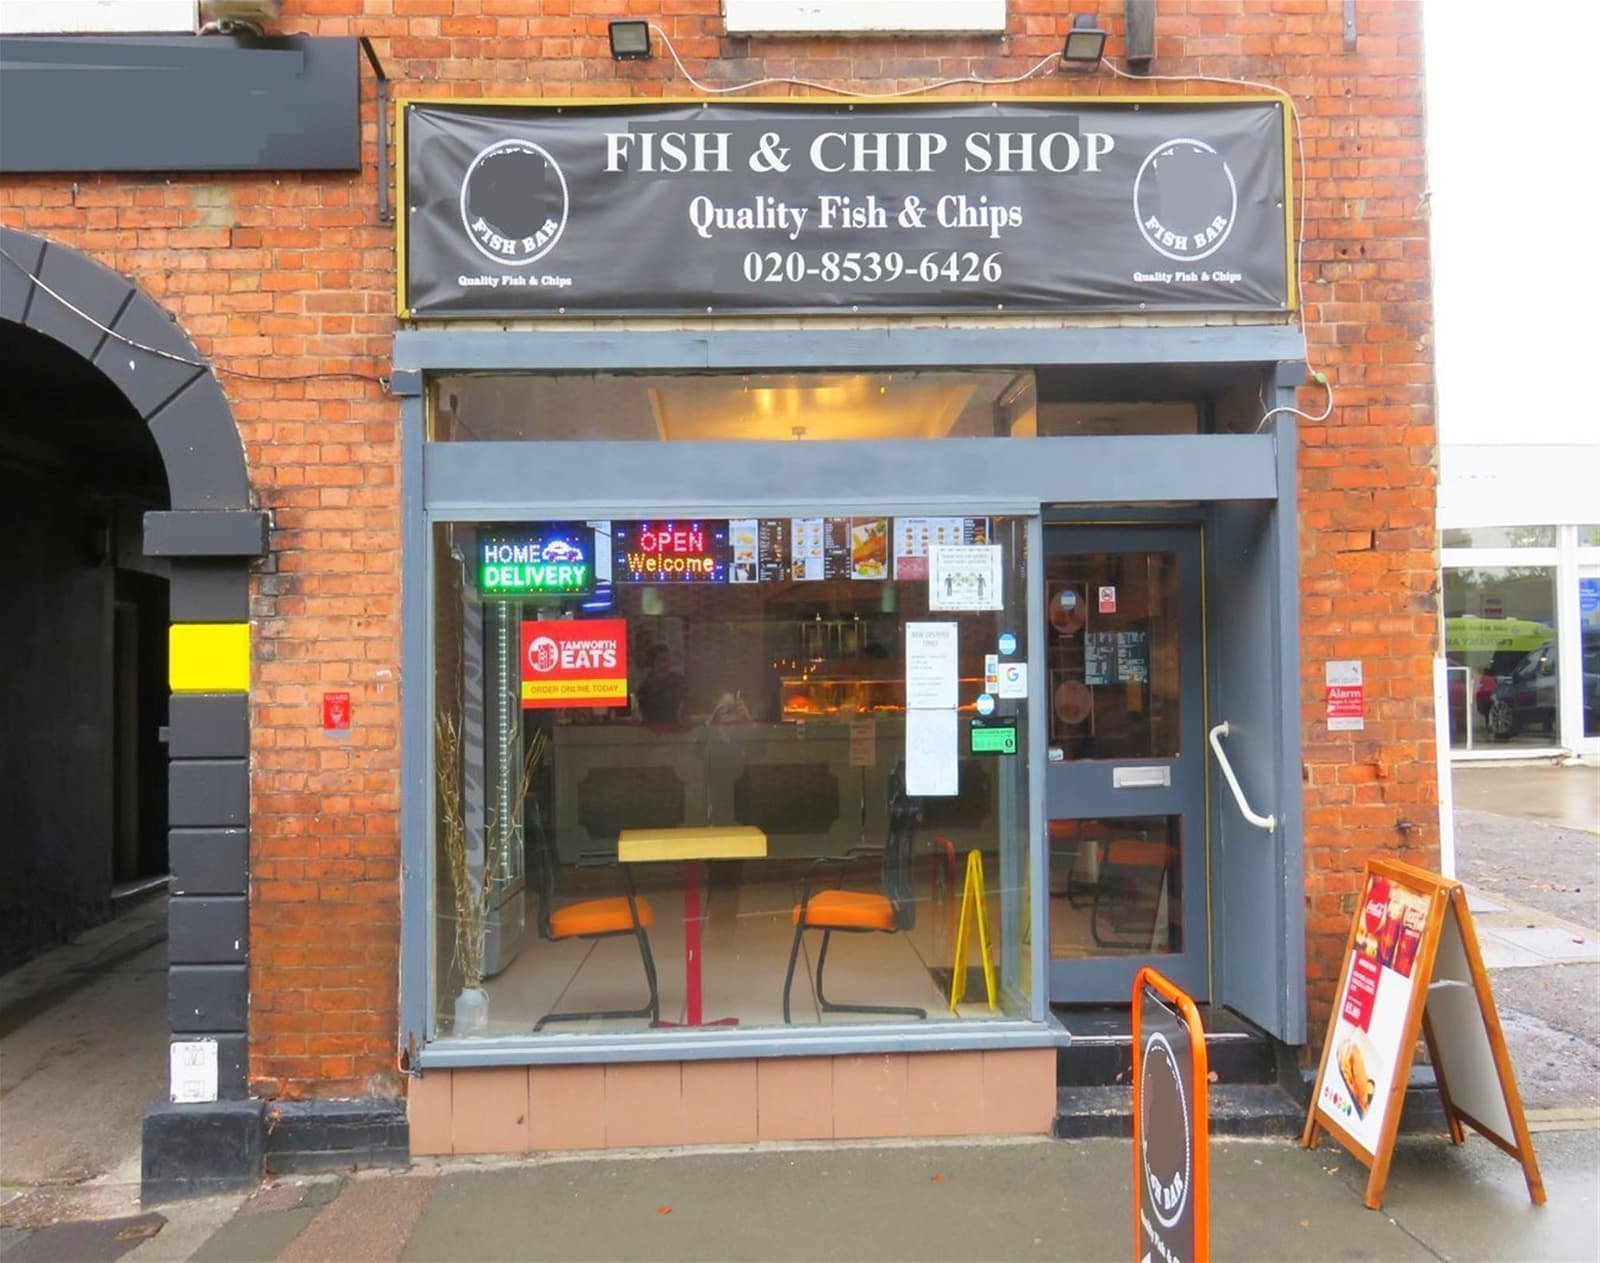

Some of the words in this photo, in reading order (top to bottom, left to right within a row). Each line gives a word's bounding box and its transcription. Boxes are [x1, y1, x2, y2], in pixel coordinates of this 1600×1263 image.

[602, 132, 733, 173] FISH
[748, 131, 791, 173] &
[809, 131, 948, 173] CHIP
[964, 131, 1115, 173] SHOP
[688, 195, 809, 241] Quality
[817, 195, 889, 230] Fish
[897, 195, 927, 230] &
[936, 194, 1024, 240] Chips
[471, 217, 517, 255] FISH
[521, 218, 559, 254] BAR
[1144, 215, 1188, 251] FISH
[1192, 214, 1228, 250] BAR
[743, 251, 1003, 283] 020-8539-6426
[458, 275, 500, 289] Quality
[501, 275, 526, 287] Fish
[528, 276, 539, 286] &
[540, 275, 573, 289] Chips
[1132, 271, 1173, 285] Quality
[1174, 272, 1198, 283] Fish
[1200, 271, 1211, 282] &
[1211, 271, 1242, 284] Chips
[640, 531, 704, 552] OPEN
[484, 544, 541, 564] HOME
[627, 553, 715, 573] Welcome
[484, 565, 587, 587] DELIVERY
[559, 640, 617, 650] TAMWORTH
[560, 649, 617, 669] EATS
[530, 686, 559, 694] ORDER
[560, 685, 591, 693] ONLINE
[592, 684, 619, 693] TODAY
[1328, 687, 1361, 698] Alarm
